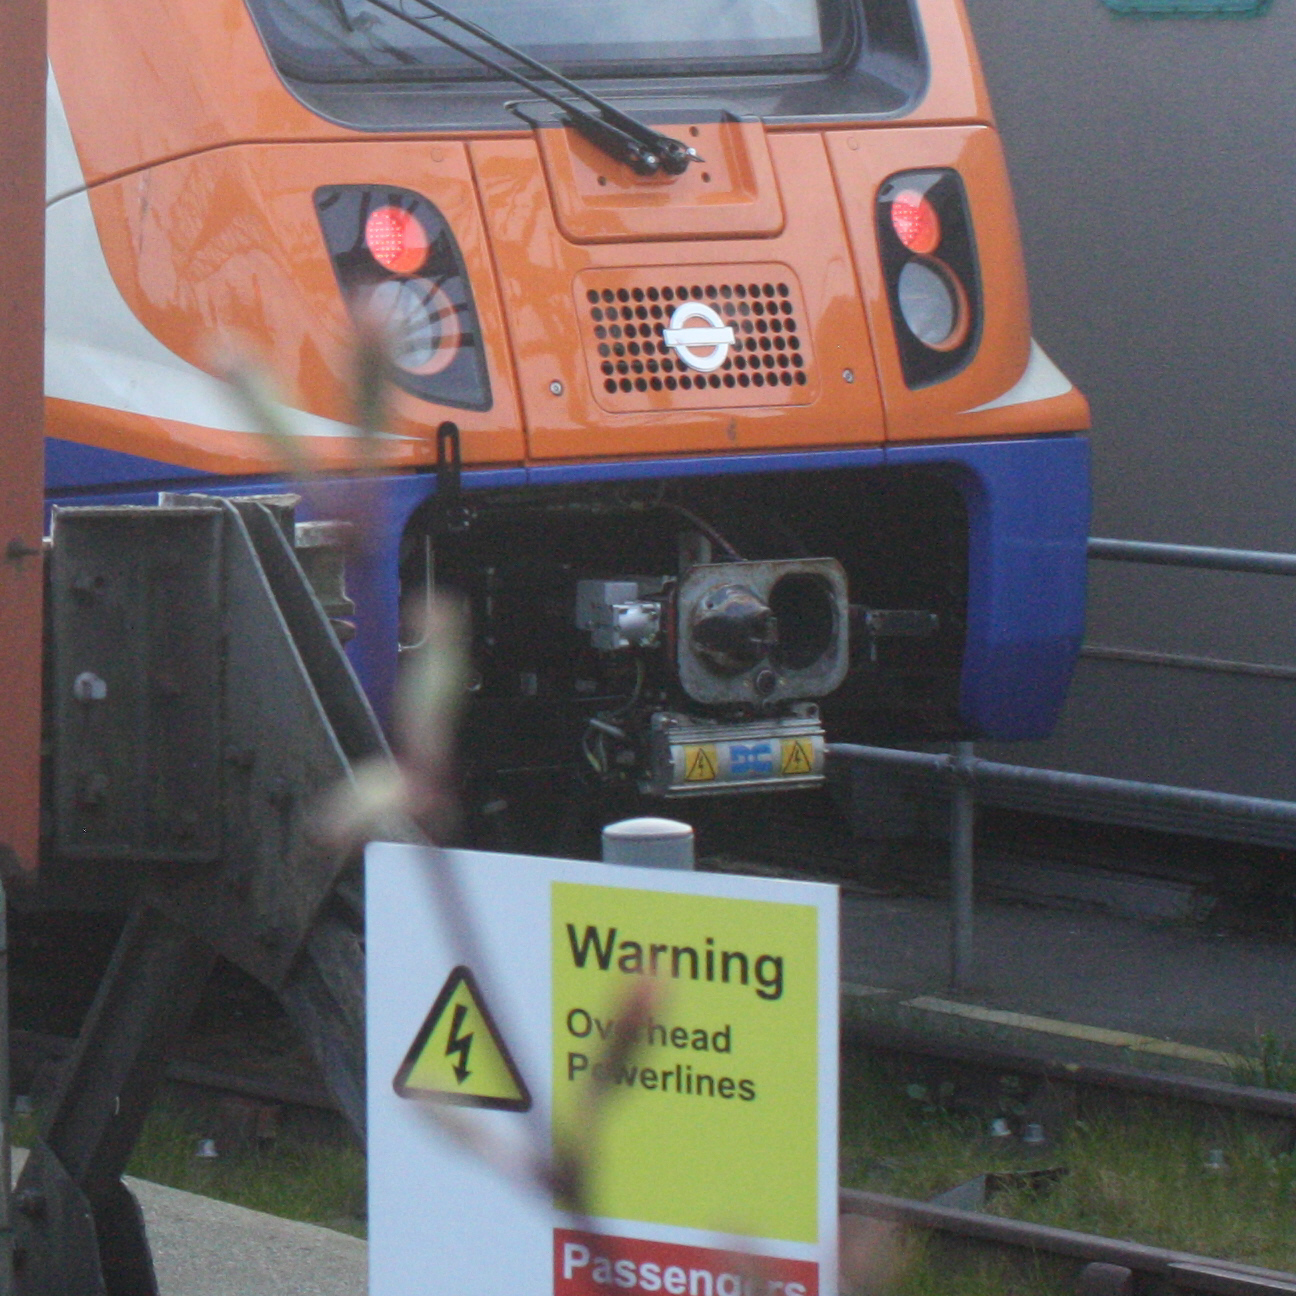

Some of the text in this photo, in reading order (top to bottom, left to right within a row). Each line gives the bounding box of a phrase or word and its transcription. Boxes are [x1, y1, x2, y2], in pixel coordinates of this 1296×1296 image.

[566, 923, 783, 1000] Warning
[566, 1008, 731, 1054] Ovhead
[563, 1242, 807, 1296] Passen
